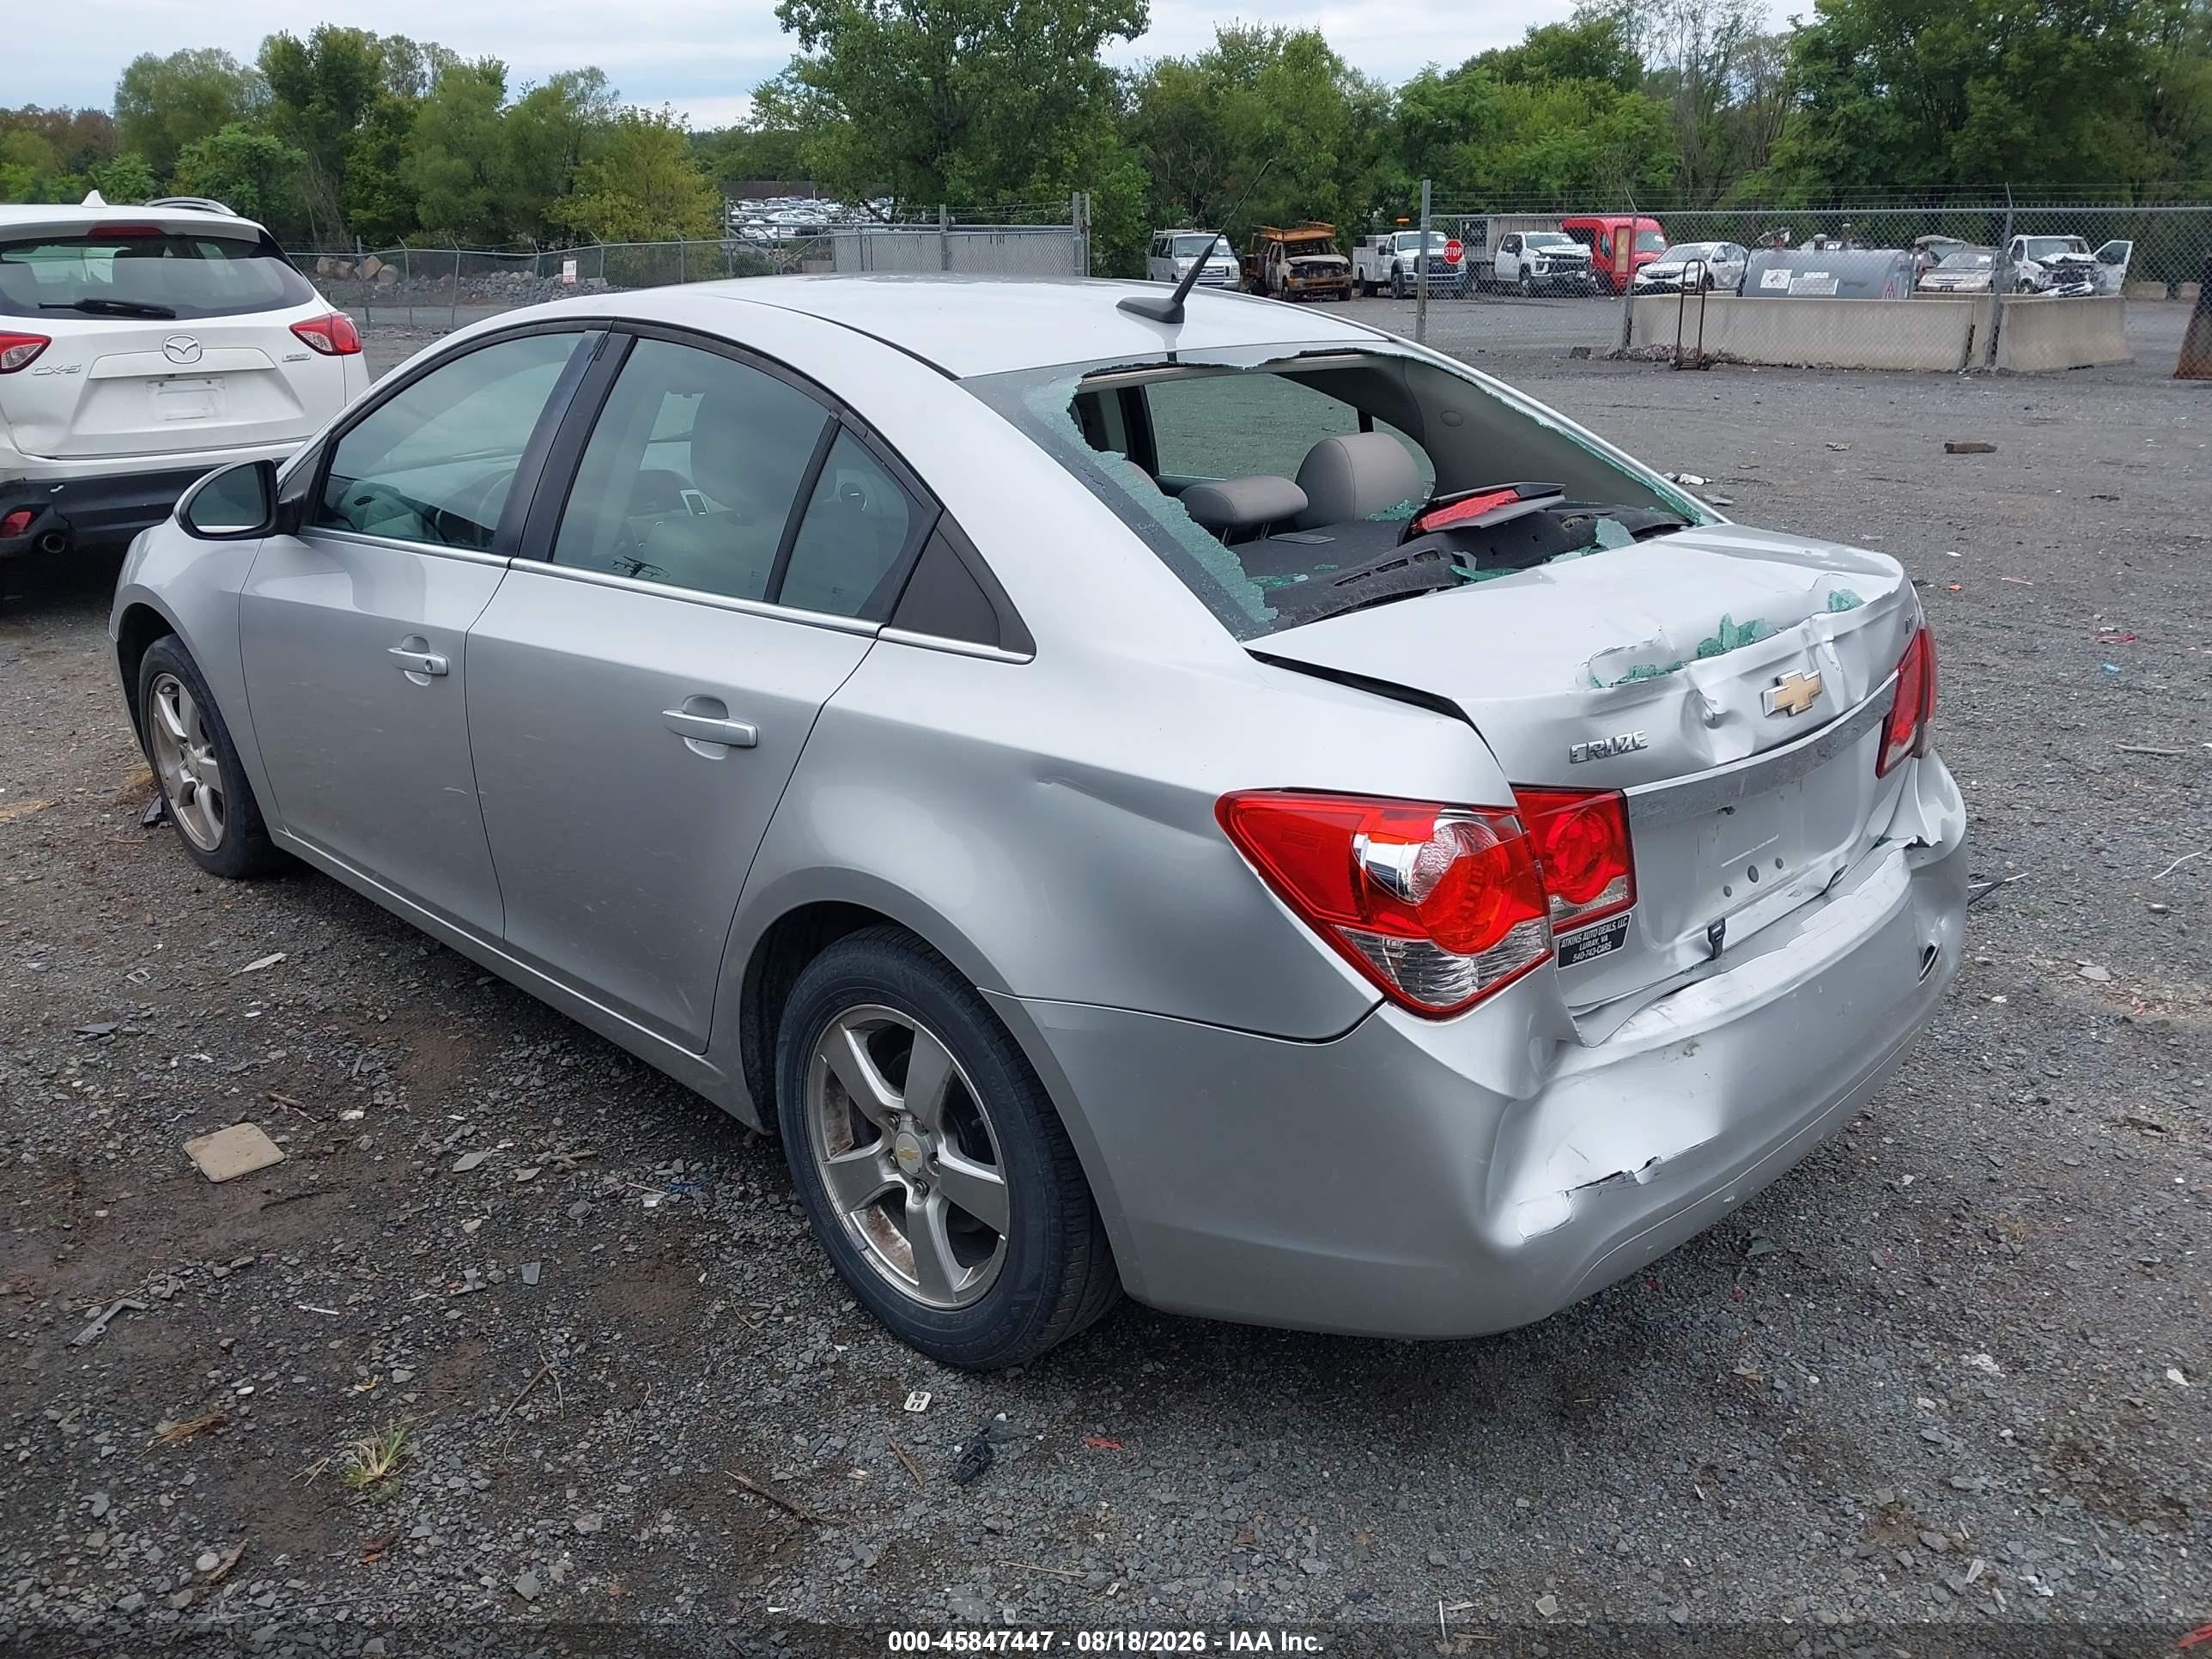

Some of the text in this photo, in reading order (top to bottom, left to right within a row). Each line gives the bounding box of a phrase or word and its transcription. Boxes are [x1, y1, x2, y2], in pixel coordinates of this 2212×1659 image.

[1444, 246, 1462, 257] STOP
[32, 363, 82, 375] CX-5
[1569, 730, 1649, 763] CRUZE
[1560, 933, 1583, 948] ATKINS
[1583, 928, 1598, 942] AUTO
[1617, 917, 1628, 929] LLC
[1601, 934, 1608, 943] VA
[1572, 941, 1613, 962] 540-743-CARS
